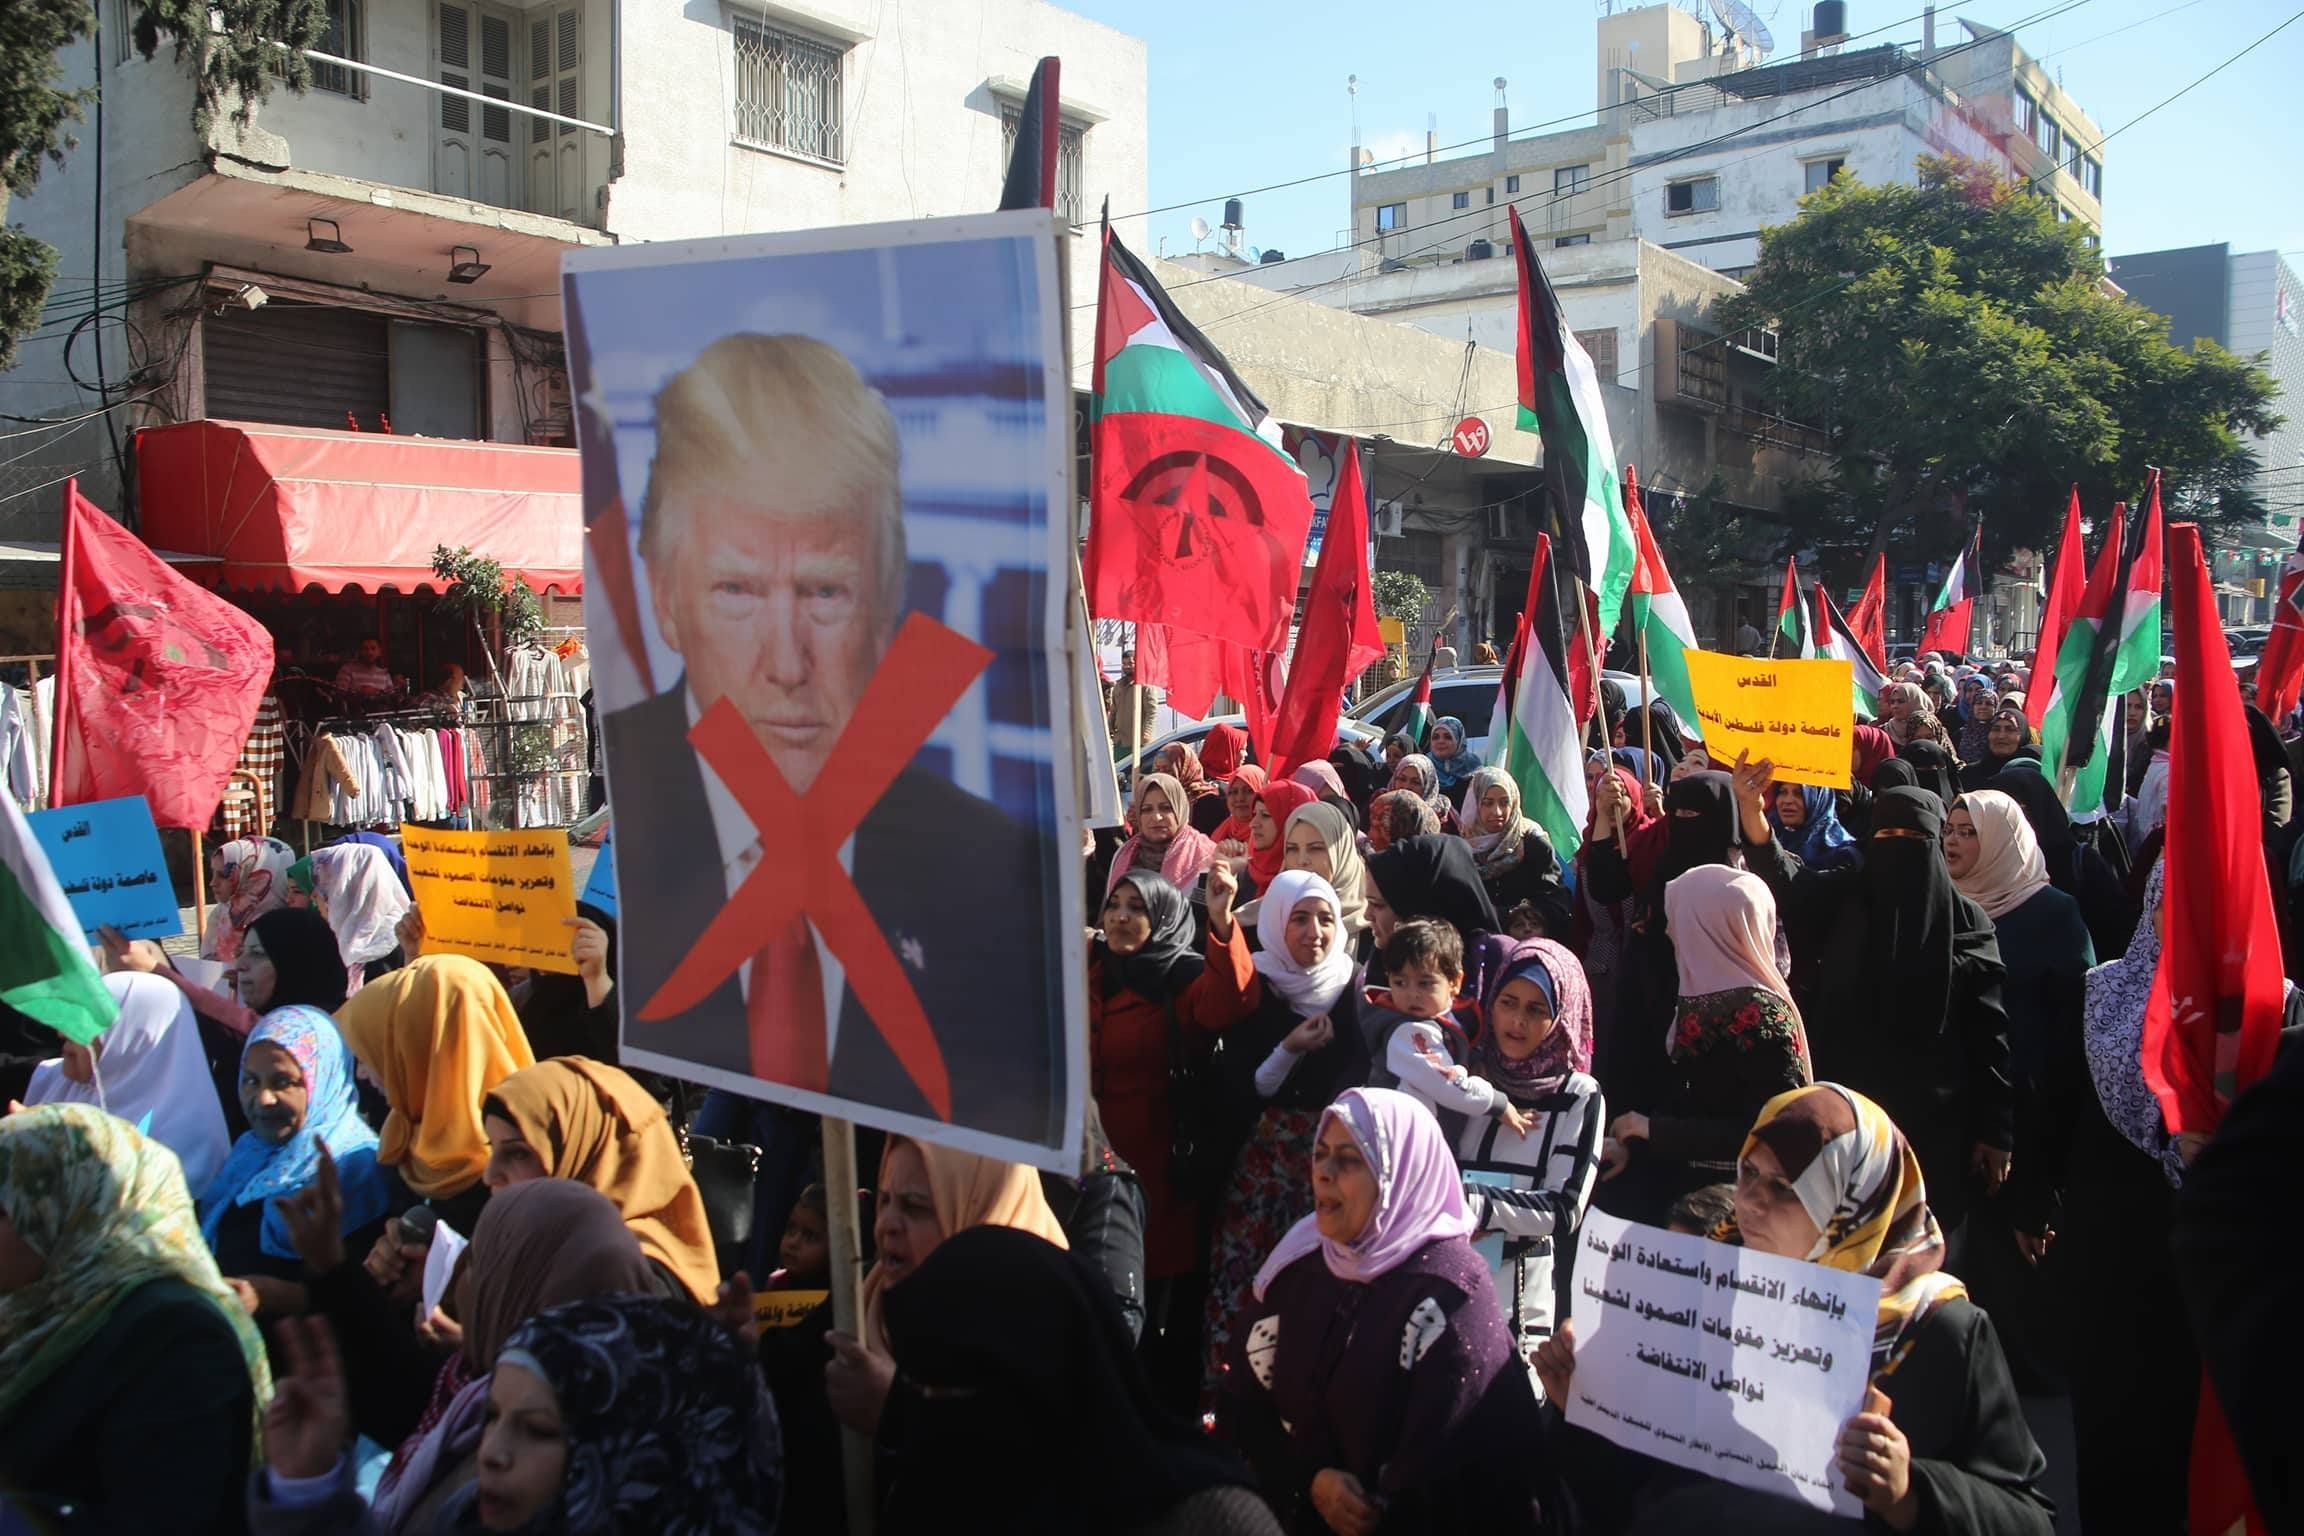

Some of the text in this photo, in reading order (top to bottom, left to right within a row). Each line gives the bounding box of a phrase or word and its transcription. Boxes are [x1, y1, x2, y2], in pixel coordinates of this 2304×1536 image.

[1737, 673, 1777, 688] القدس
[1724, 718, 1765, 733] فلسطين
[1768, 720, 1796, 736] دولة
[1800, 721, 1840, 738] عاصمة
[63, 878, 90, 898] فلسطي
[1587, 1229, 1846, 1320] بإنهاء الانقسام واستعادة الوحدة
[1583, 1276, 1833, 1372] وتعزيز مقومات الصمود لشعبنا
[1636, 1342, 1765, 1402] نواصل الانتفاضة
